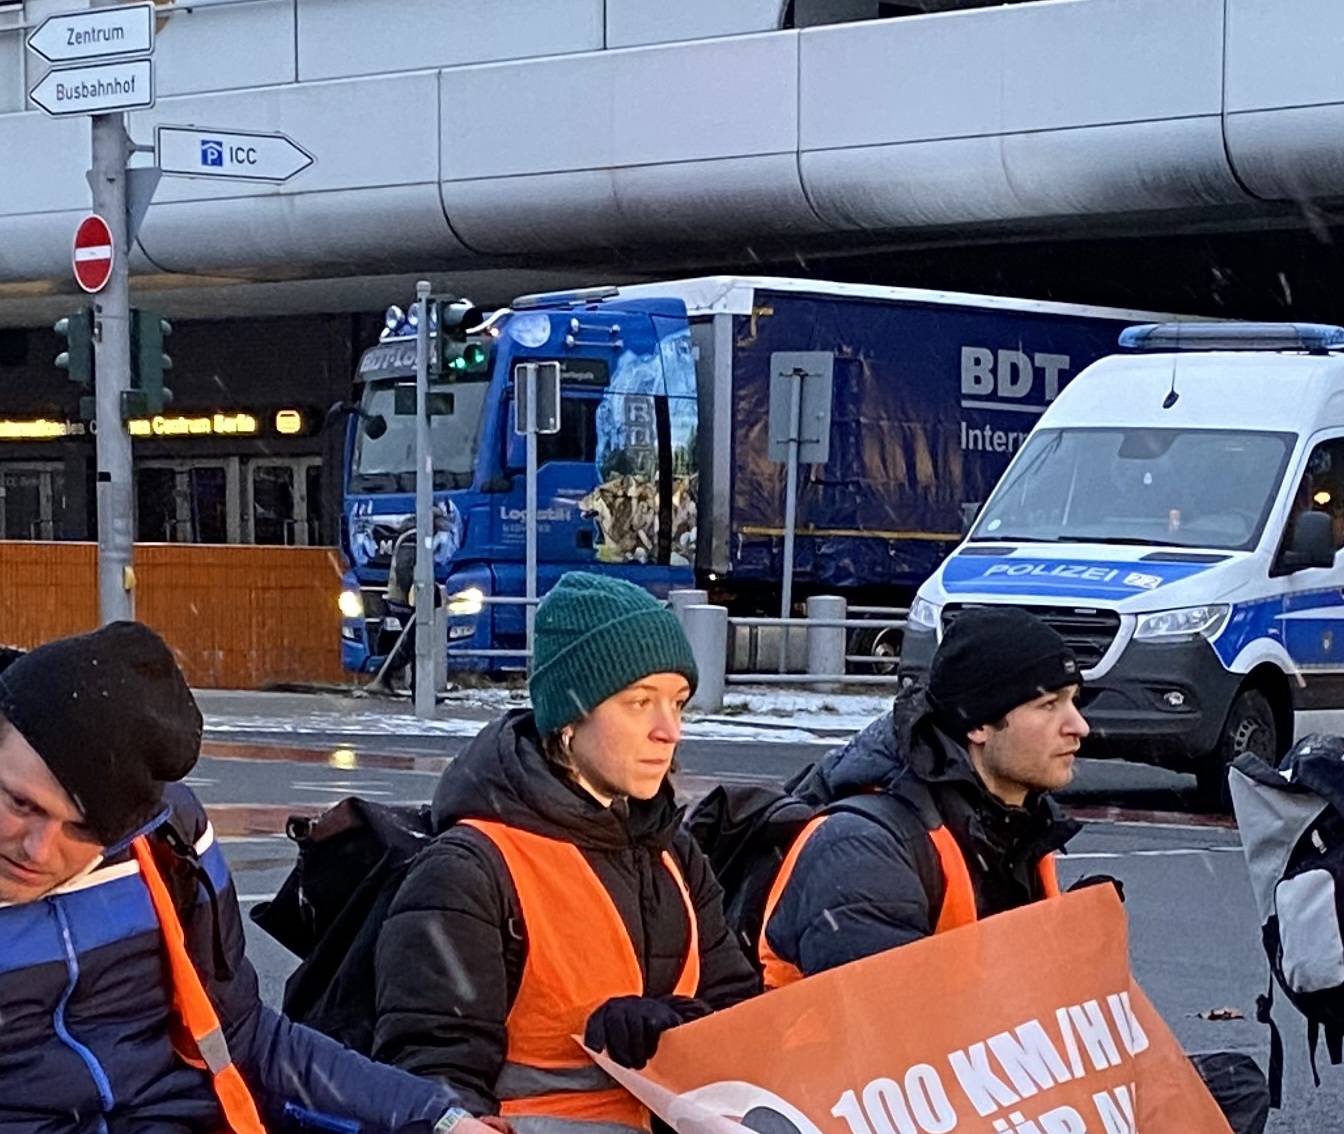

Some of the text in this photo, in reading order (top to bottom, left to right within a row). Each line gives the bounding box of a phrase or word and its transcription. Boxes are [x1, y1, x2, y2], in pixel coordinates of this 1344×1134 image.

[66, 25, 125, 46] Zentrum
[56, 75, 136, 101] Busbahnhof
[229, 146, 257, 165] ICC
[961, 346, 1070, 401] BDT
[983, 563, 1119, 582] POLIZEI
[947, 999, 1122, 1117] KM/H
